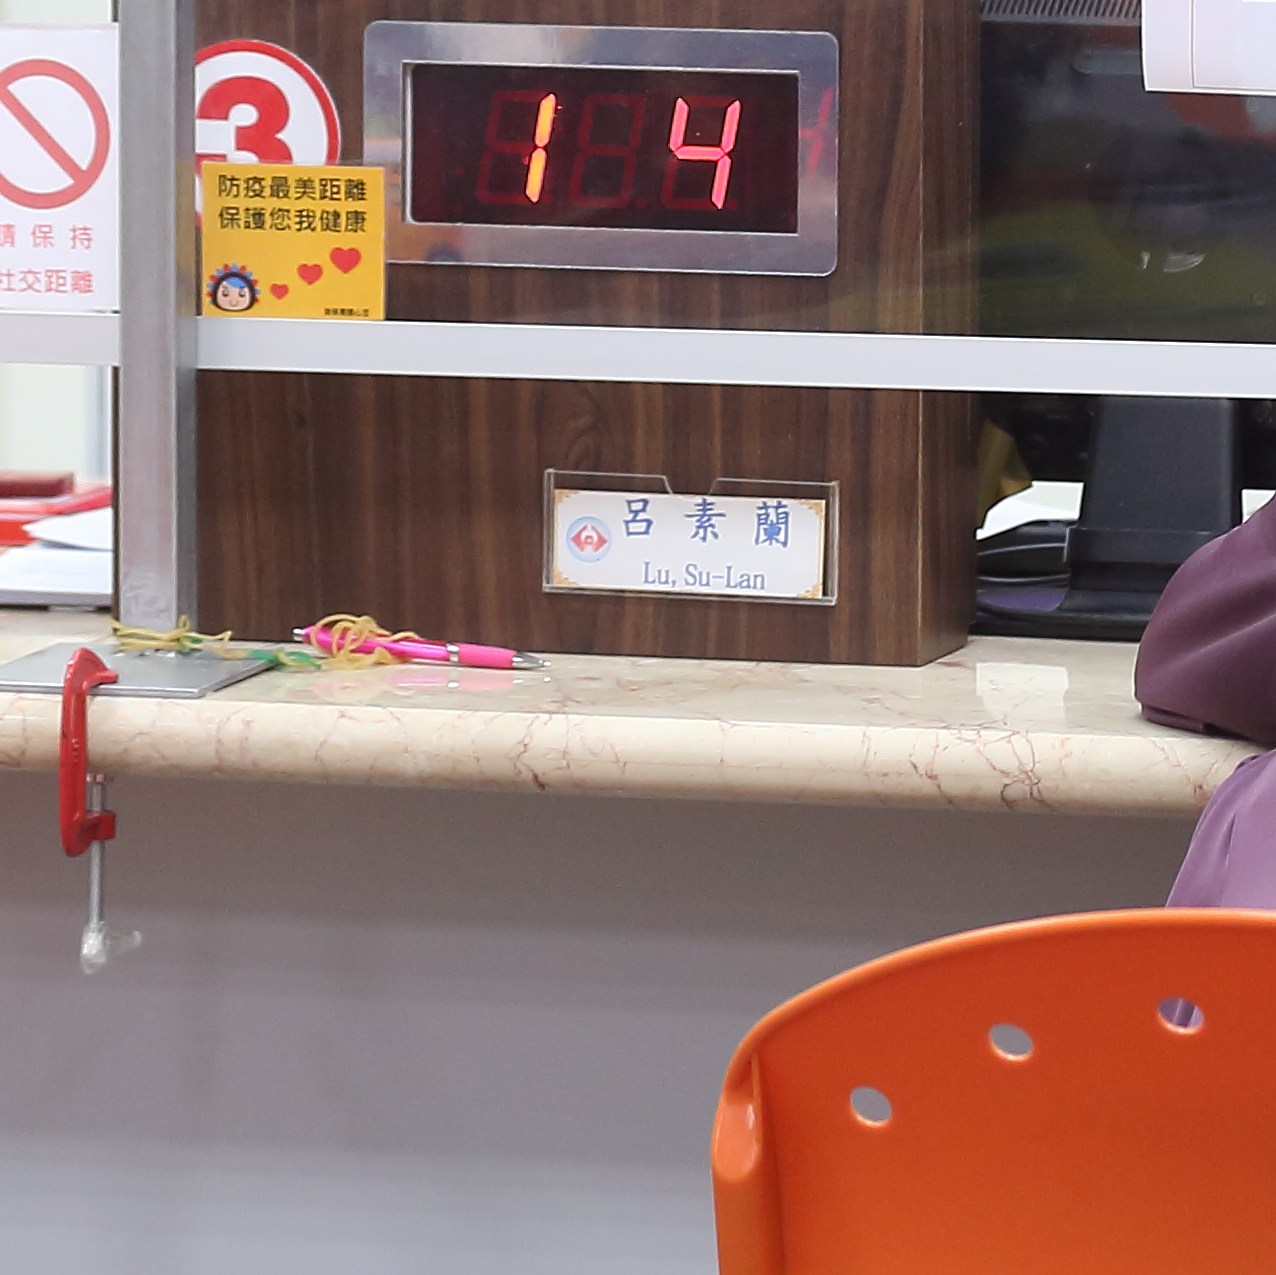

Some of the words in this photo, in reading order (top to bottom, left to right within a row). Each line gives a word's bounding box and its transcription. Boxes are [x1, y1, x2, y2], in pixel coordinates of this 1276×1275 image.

[217, 174, 367, 201] 防疫最美距離
[218, 206, 367, 233] 保護您我健康
[622, 498, 790, 548] 呂素蘭
